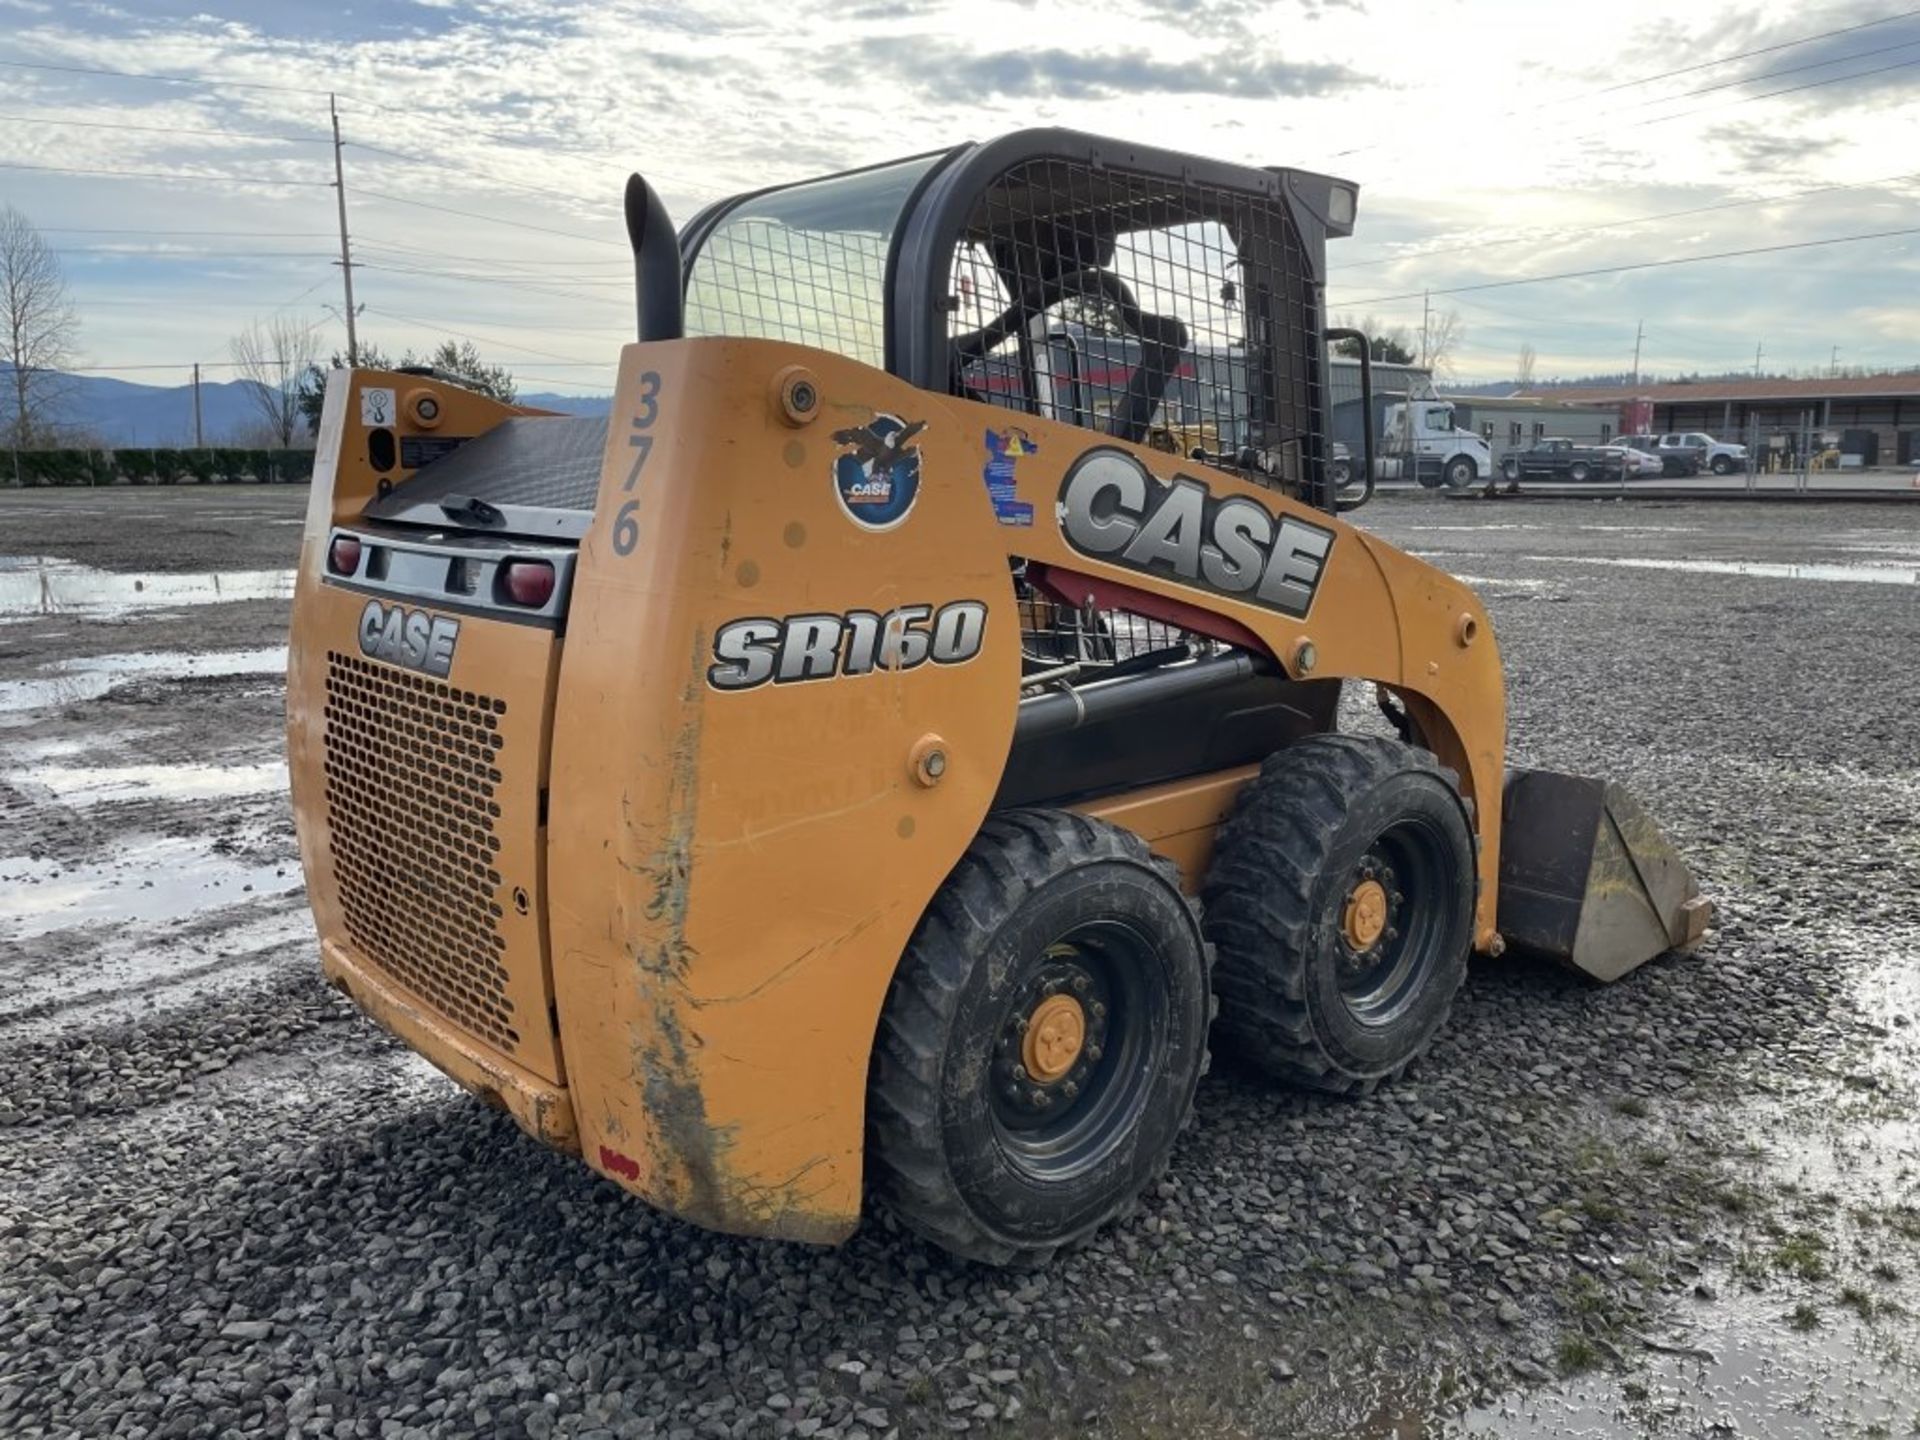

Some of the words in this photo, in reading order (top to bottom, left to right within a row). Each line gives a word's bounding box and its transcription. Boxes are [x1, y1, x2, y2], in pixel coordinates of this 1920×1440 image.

[612, 371, 661, 556] 376
[851, 482, 891, 496] CASE
[1062, 449, 1334, 612] CASE
[360, 600, 459, 676] CASE
[708, 600, 988, 689] SR160
